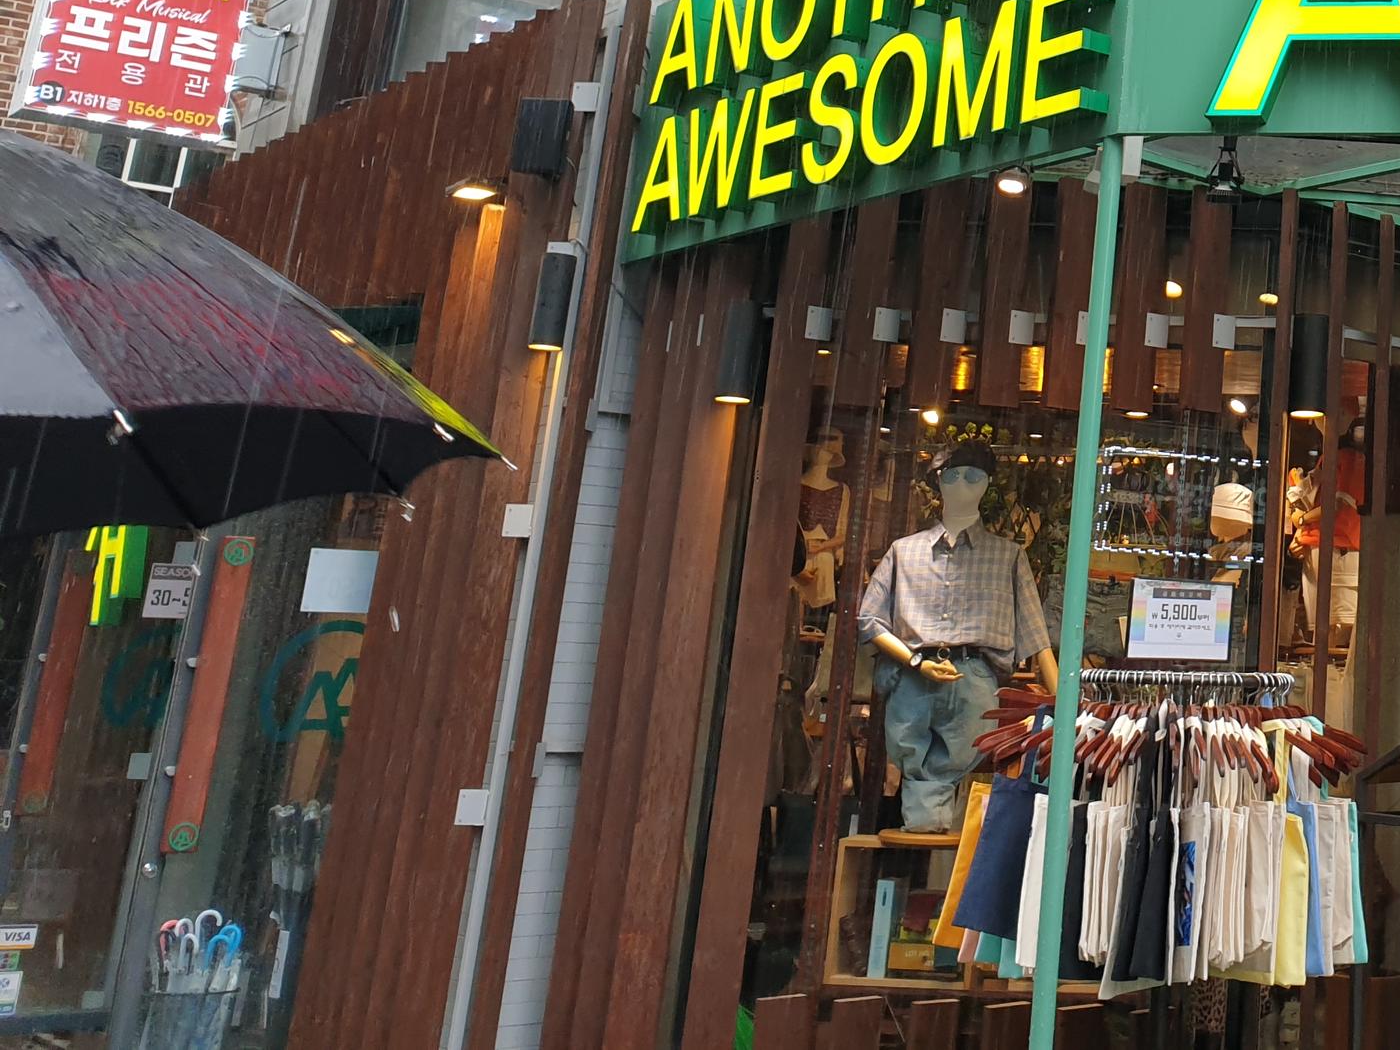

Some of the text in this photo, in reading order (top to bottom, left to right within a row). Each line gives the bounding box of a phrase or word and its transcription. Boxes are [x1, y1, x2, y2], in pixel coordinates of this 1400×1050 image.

[59, 4, 220, 74] 프리즌
[40, 82, 217, 128] B1 지하1층 1566-0507
[1161, 603, 1198, 621] 5,900
[4, 931, 31, 943] VISA
